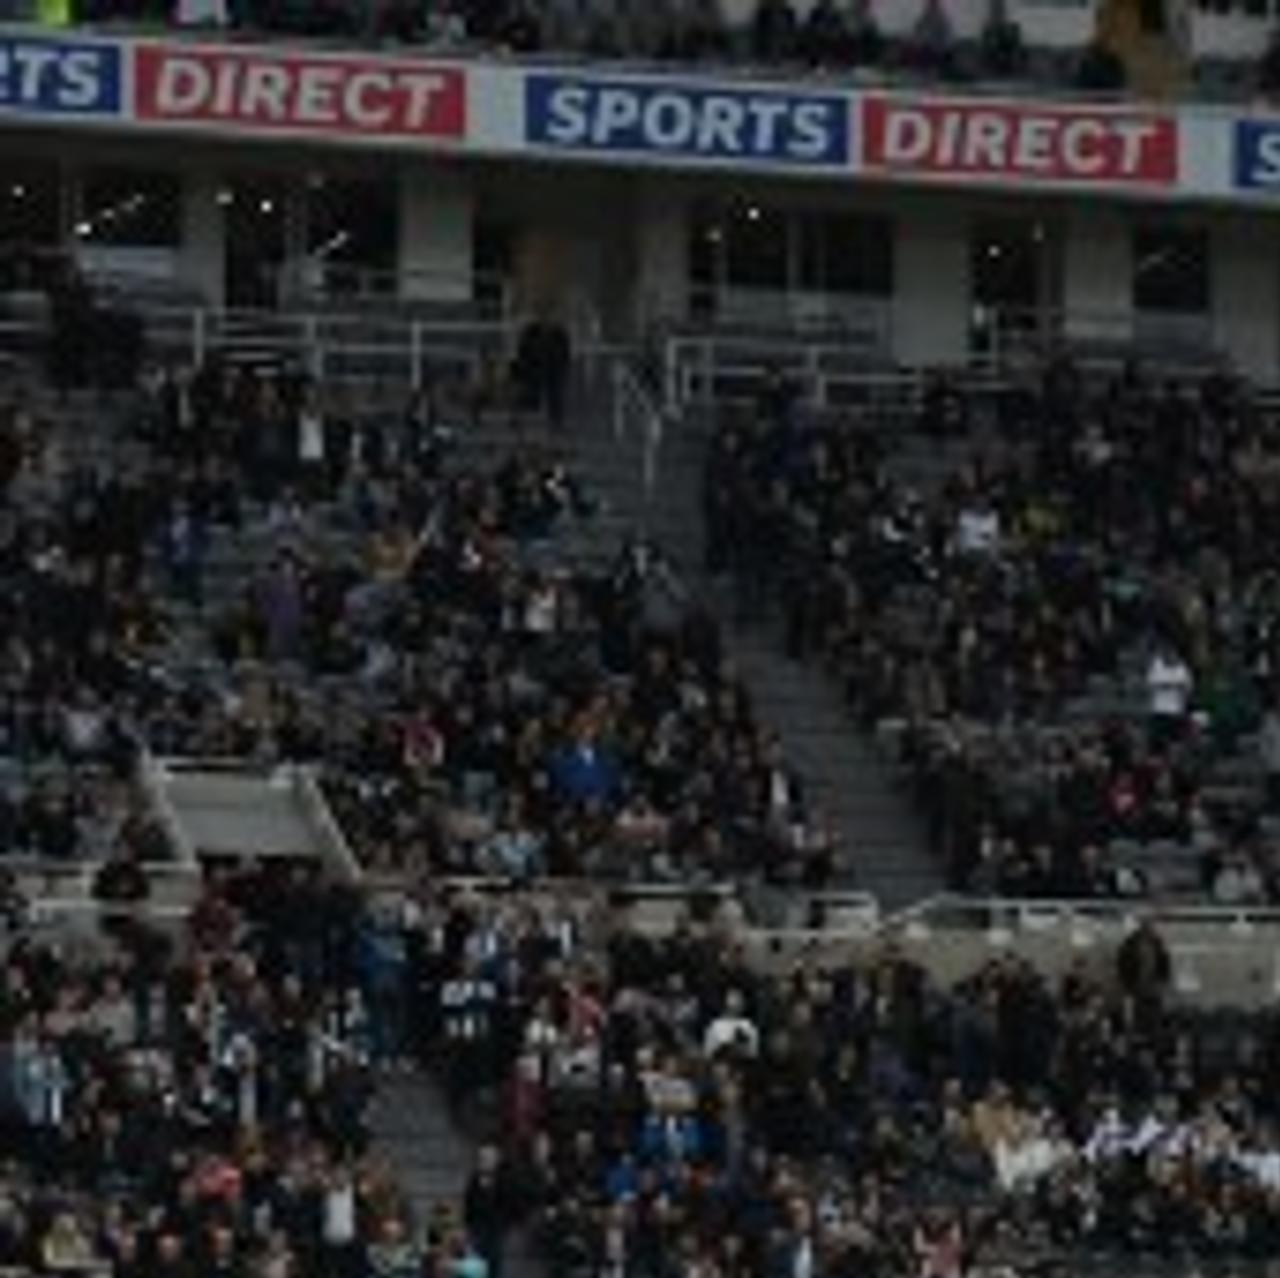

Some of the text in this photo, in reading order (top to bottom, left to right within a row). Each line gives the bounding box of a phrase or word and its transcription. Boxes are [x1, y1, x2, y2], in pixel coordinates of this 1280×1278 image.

[0, 46, 446, 129] TS DIRECT
[545, 85, 1156, 174] SPORTS DIRECT
